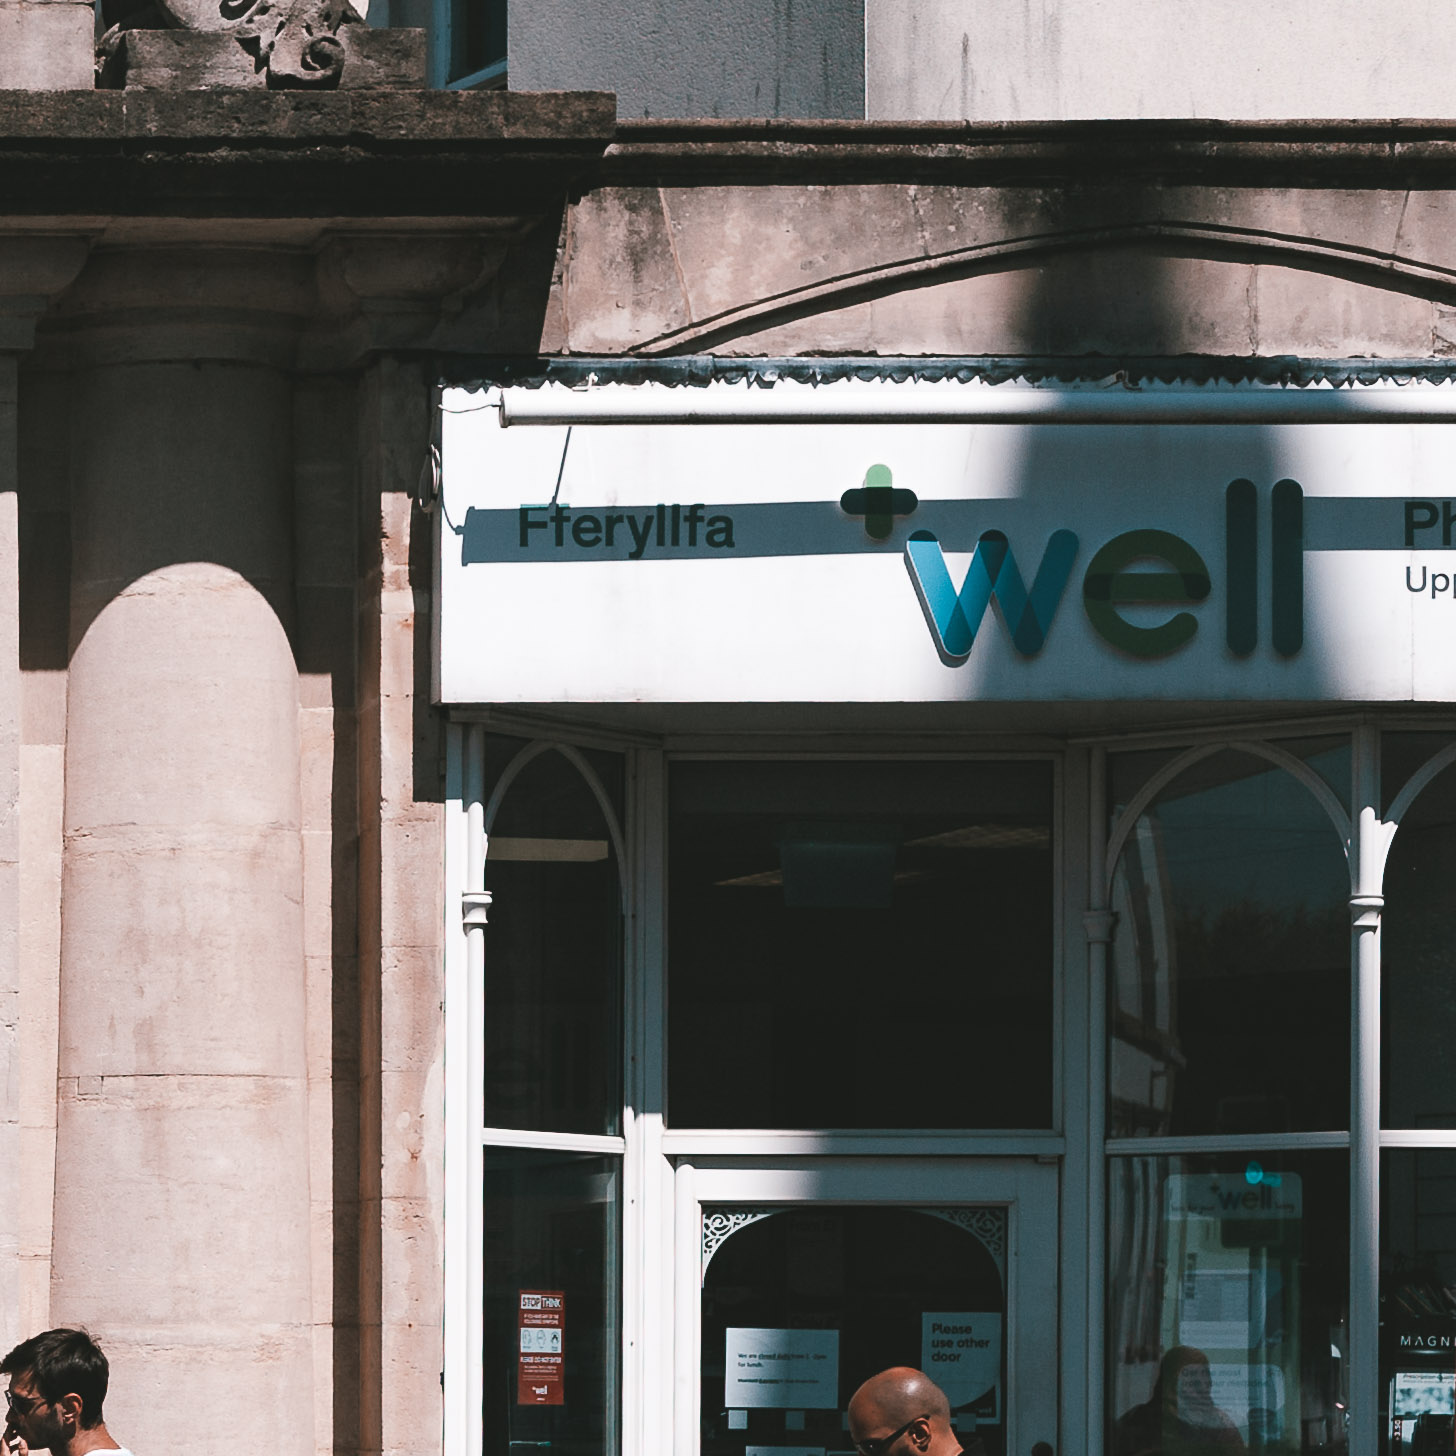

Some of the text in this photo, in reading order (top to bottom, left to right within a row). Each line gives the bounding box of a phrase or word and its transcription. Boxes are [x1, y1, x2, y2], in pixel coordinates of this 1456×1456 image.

[518, 503, 736, 560] Fferyllfa
[903, 478, 1304, 666] well
[1405, 566, 1456, 599] Up
[1217, 1184, 1272, 1210] well
[523, 1297, 561, 1308] STOP THINK
[932, 1323, 972, 1334] Please
[932, 1338, 990, 1348] use other
[932, 1352, 961, 1362] door
